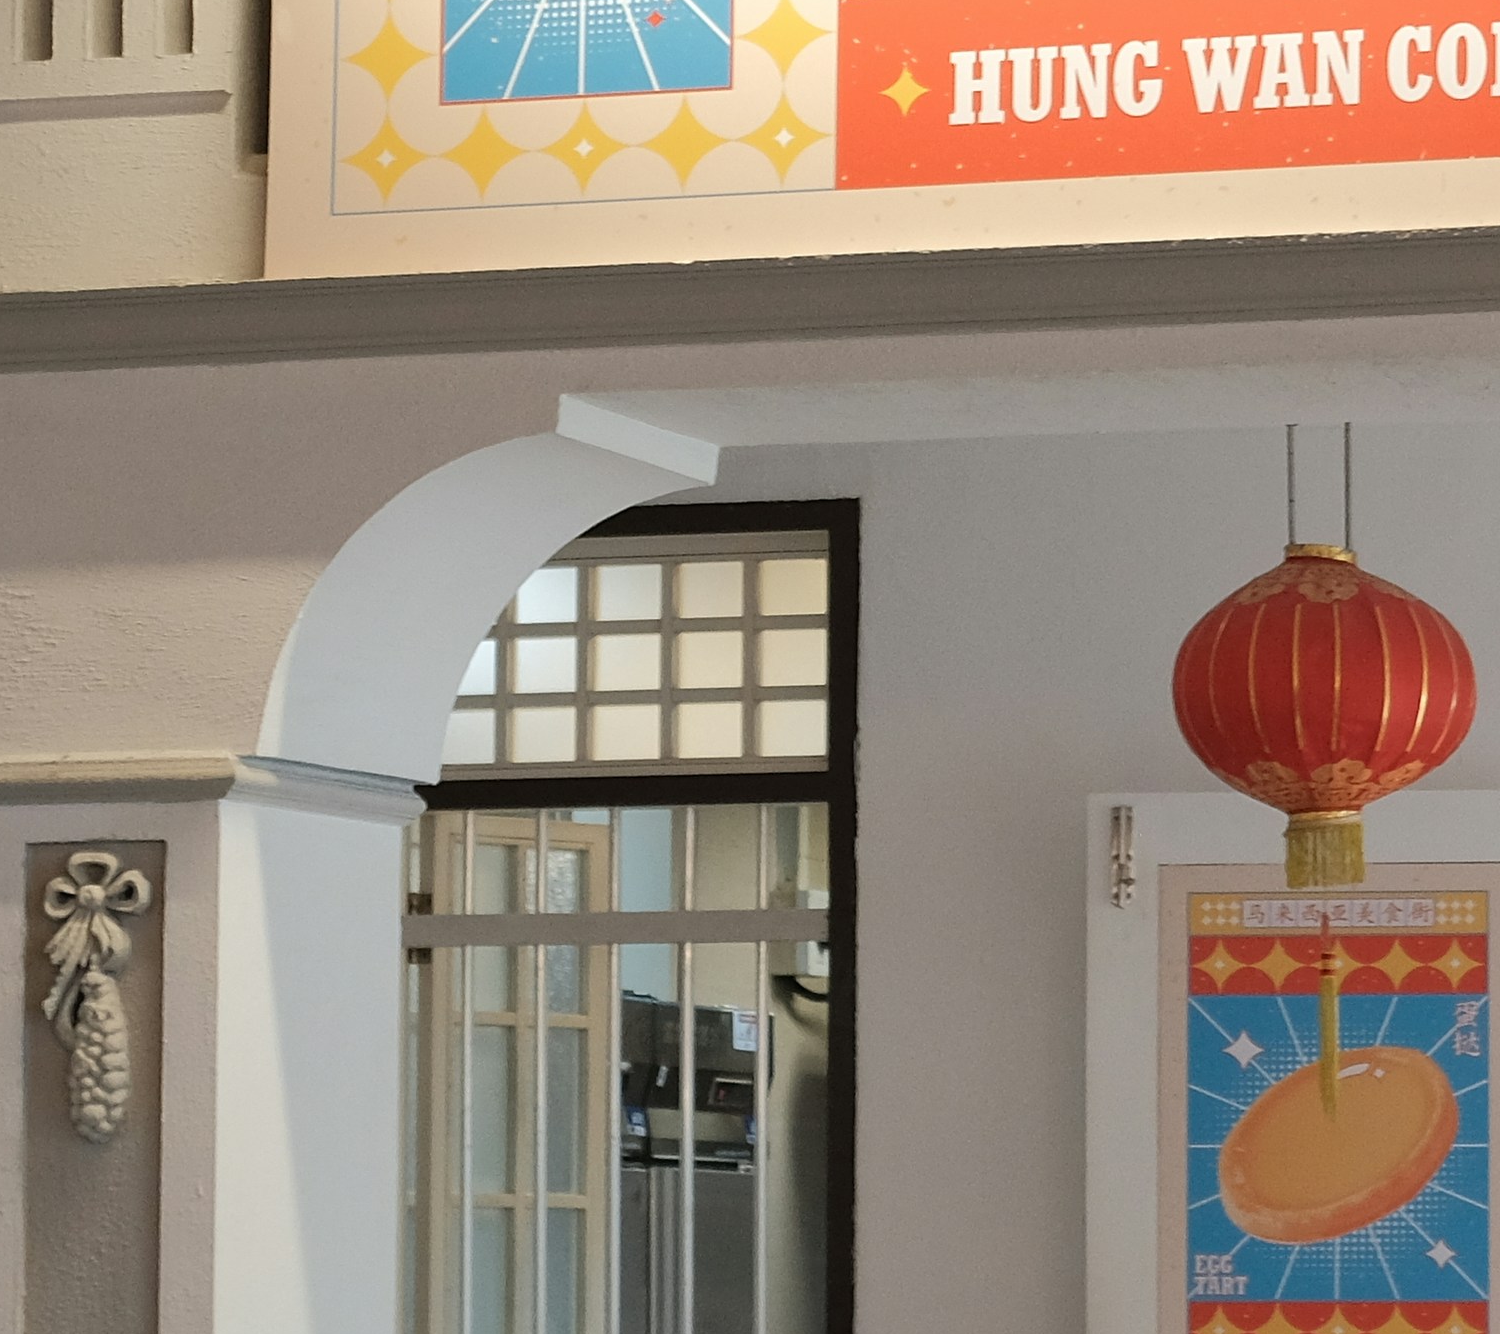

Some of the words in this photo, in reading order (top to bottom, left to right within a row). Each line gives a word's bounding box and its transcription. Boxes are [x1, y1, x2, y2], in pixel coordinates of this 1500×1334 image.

[949, 38, 1163, 128] HUNG
[1183, 28, 1365, 115] WAN
[1194, 1254, 1235, 1274] EGG
[1194, 1276, 1249, 1296] TART
